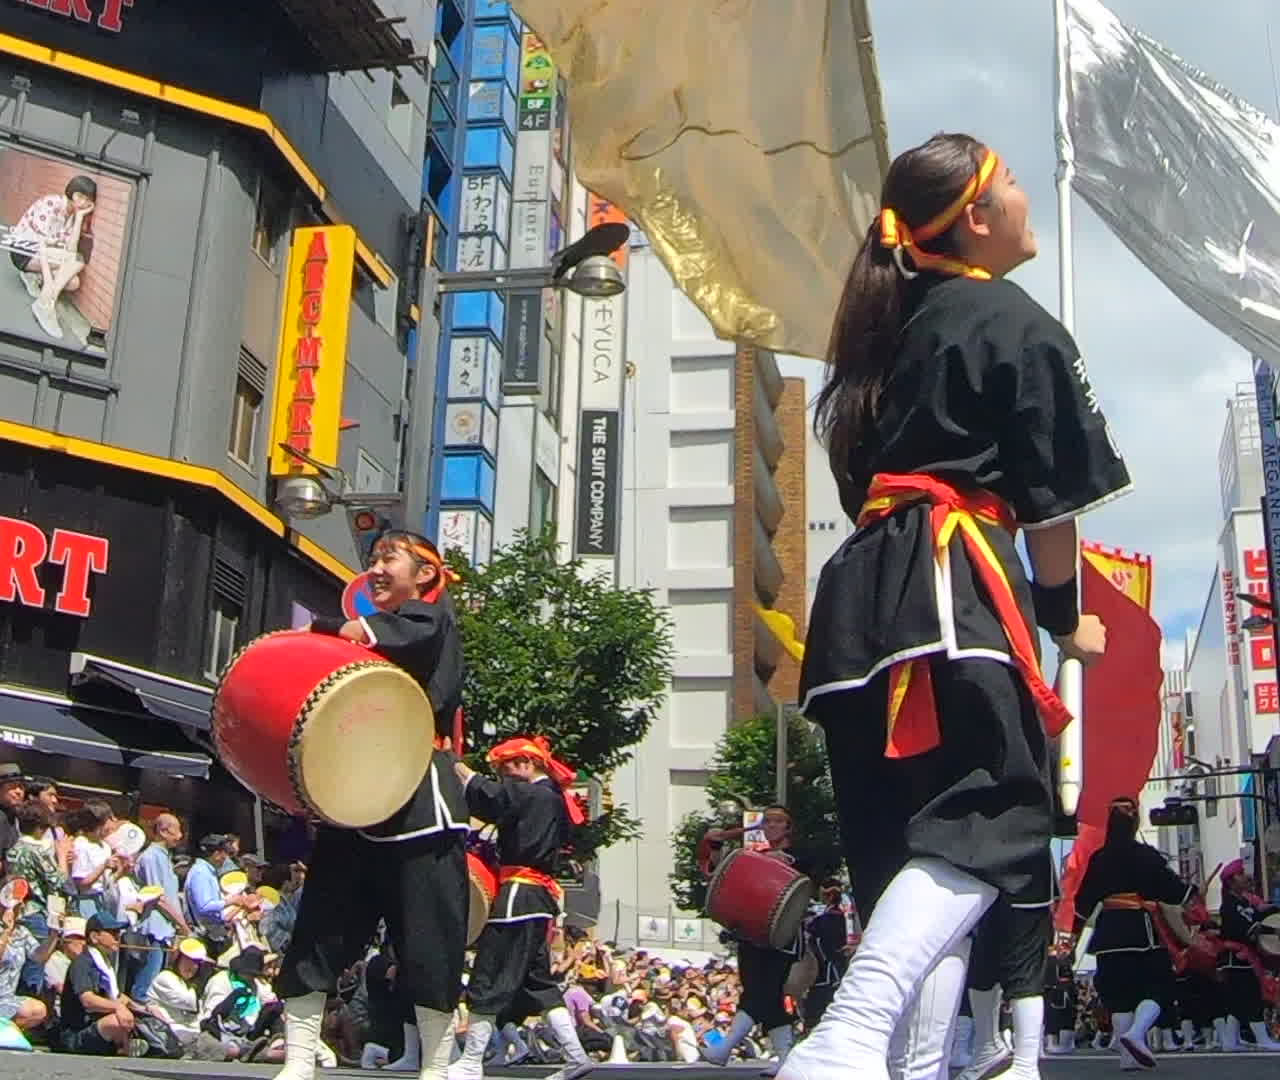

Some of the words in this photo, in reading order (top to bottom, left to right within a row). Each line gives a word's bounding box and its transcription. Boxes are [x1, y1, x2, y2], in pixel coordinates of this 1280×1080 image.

[522, 114, 547, 129] 4F
[593, 416, 609, 444] THE
[591, 446, 607, 482] SUIT
[587, 482, 607, 550] COMPANY
